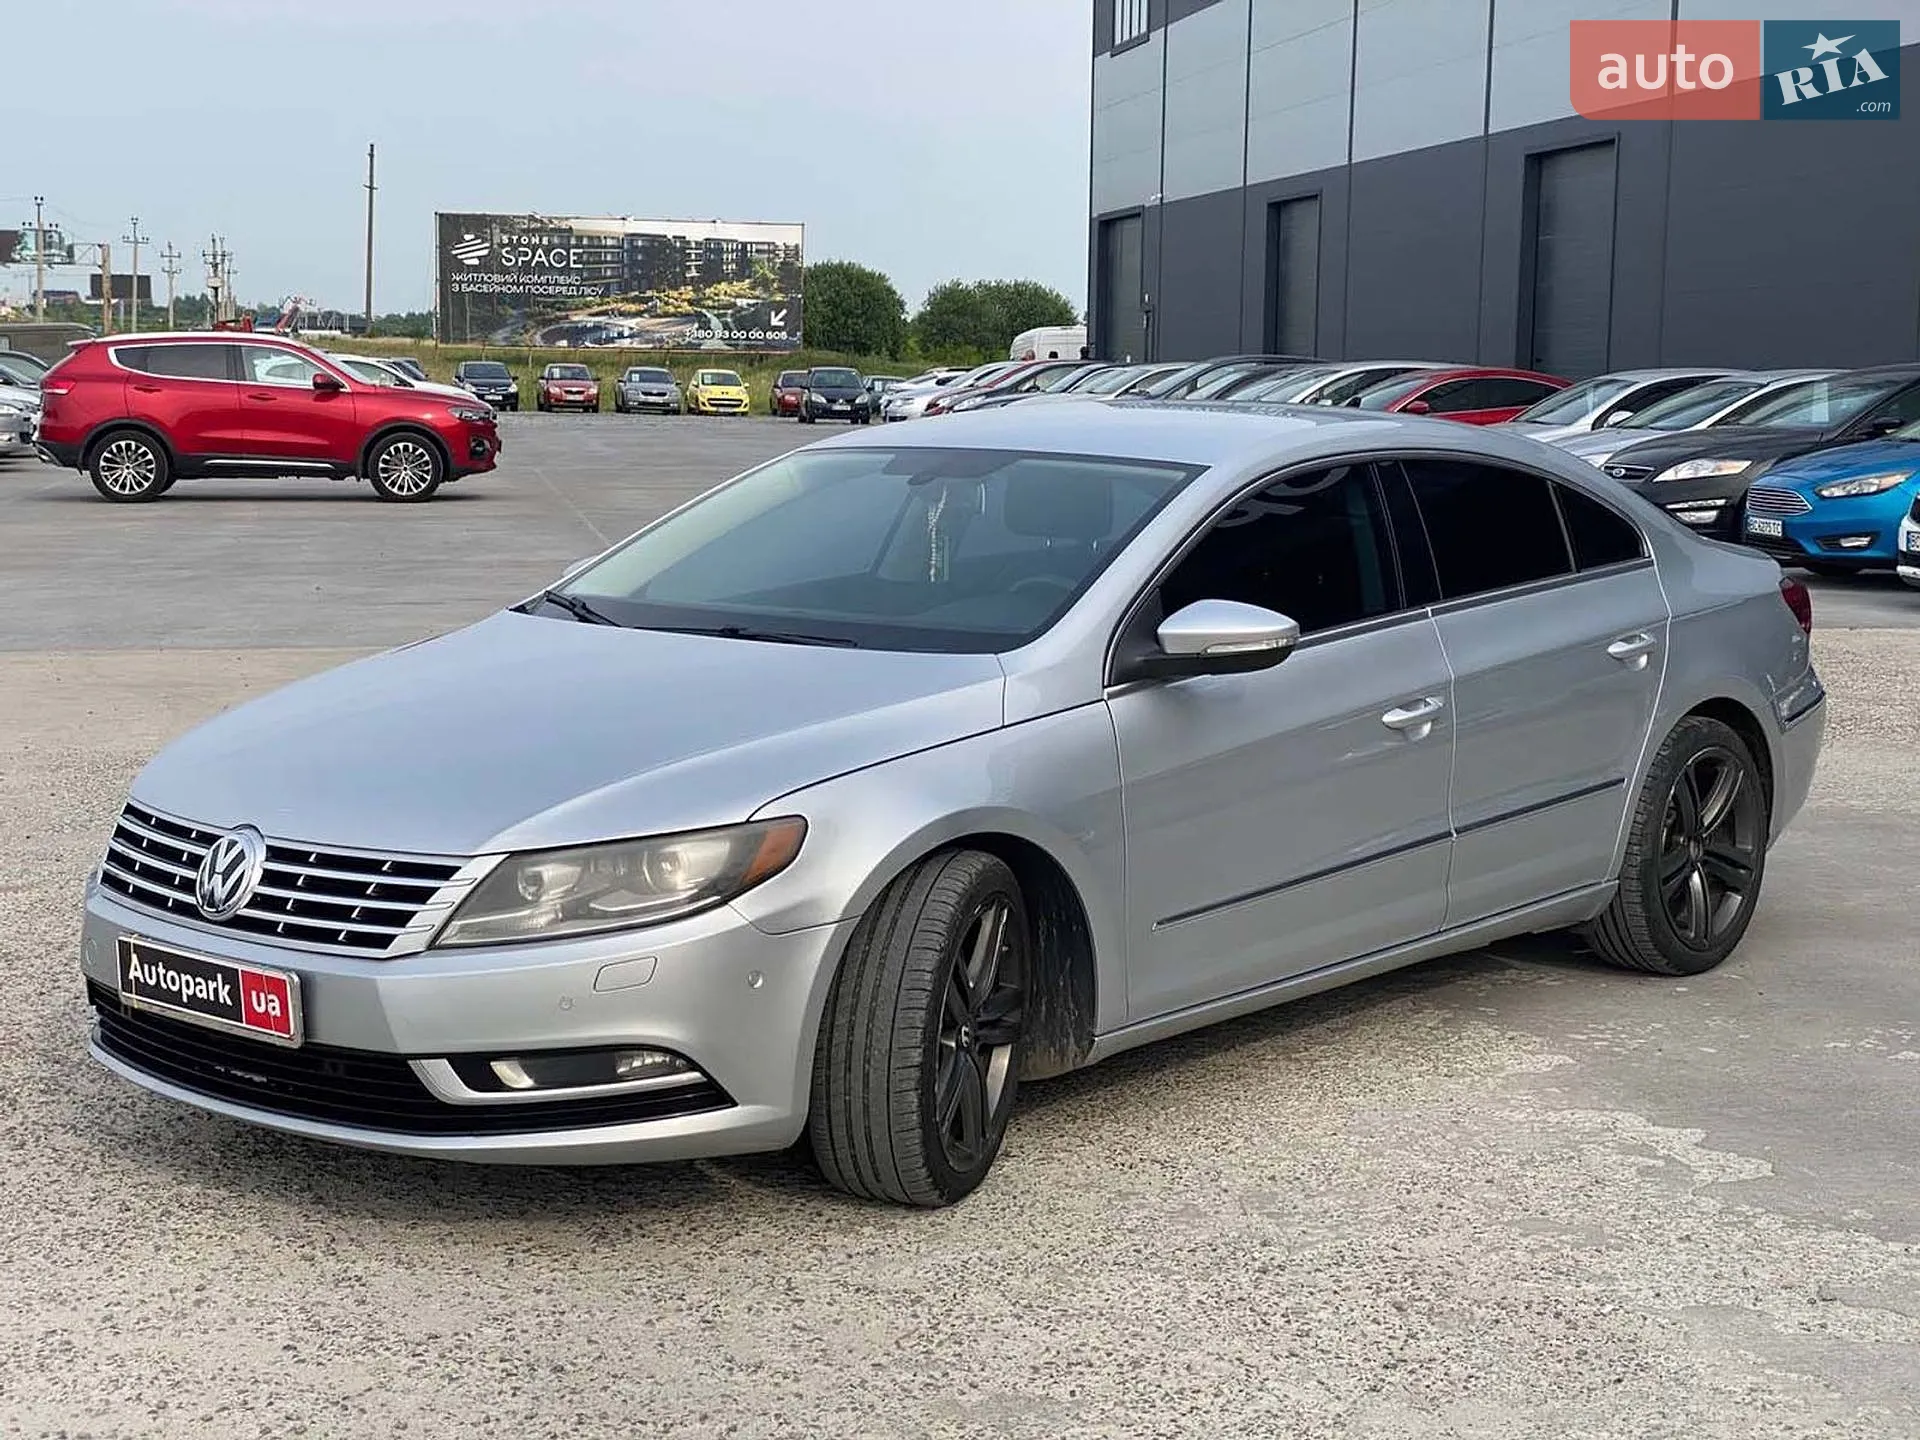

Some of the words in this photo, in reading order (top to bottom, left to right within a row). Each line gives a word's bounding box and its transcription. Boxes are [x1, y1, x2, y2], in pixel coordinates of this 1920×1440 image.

[501, 235, 549, 245] STONE
[501, 247, 584, 268] SPACE
[451, 272, 519, 284] ЖИТЛОВИЙ
[461, 283, 525, 294] БАСЕЙНОМ
[525, 284, 577, 296] ПОСЕРЕД
[128, 952, 233, 1007] Autopark
[251, 989, 281, 1018] ua
